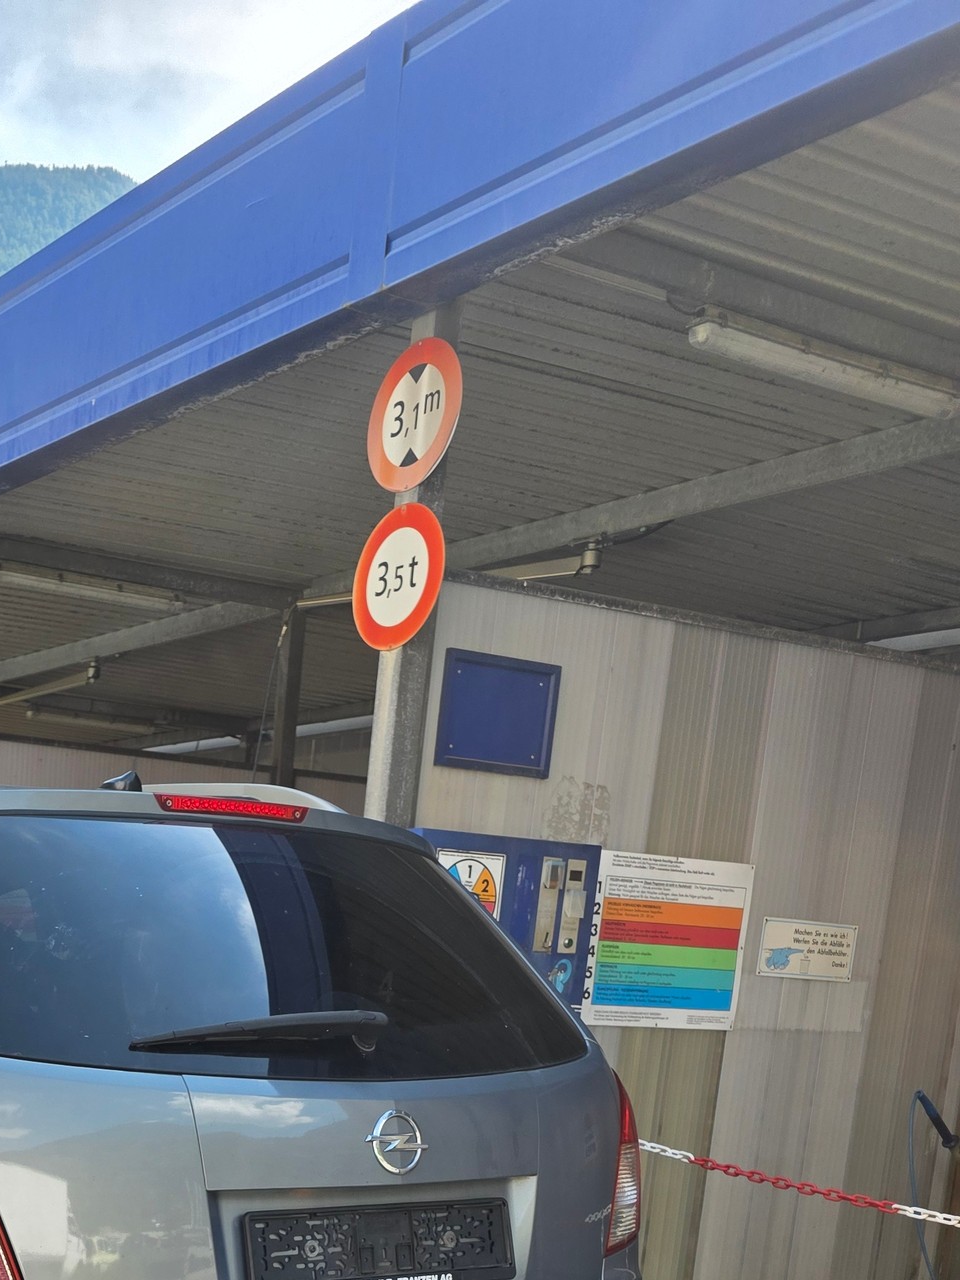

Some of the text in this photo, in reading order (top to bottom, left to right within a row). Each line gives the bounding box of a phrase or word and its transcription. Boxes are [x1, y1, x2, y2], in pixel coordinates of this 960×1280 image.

[468, 864, 473, 879] 1
[481, 878, 489, 893] 2
[597, 880, 602, 894] 1
[593, 902, 601, 915] 2
[590, 923, 598, 937] 3
[814, 929, 822, 937] Sie
[793, 937, 810, 945] Werfen
[811, 938, 819, 946] Sie
[820, 938, 828, 946] die
[588, 945, 595, 958] 4
[585, 966, 593, 979] 5
[583, 988, 590, 1000] 6
